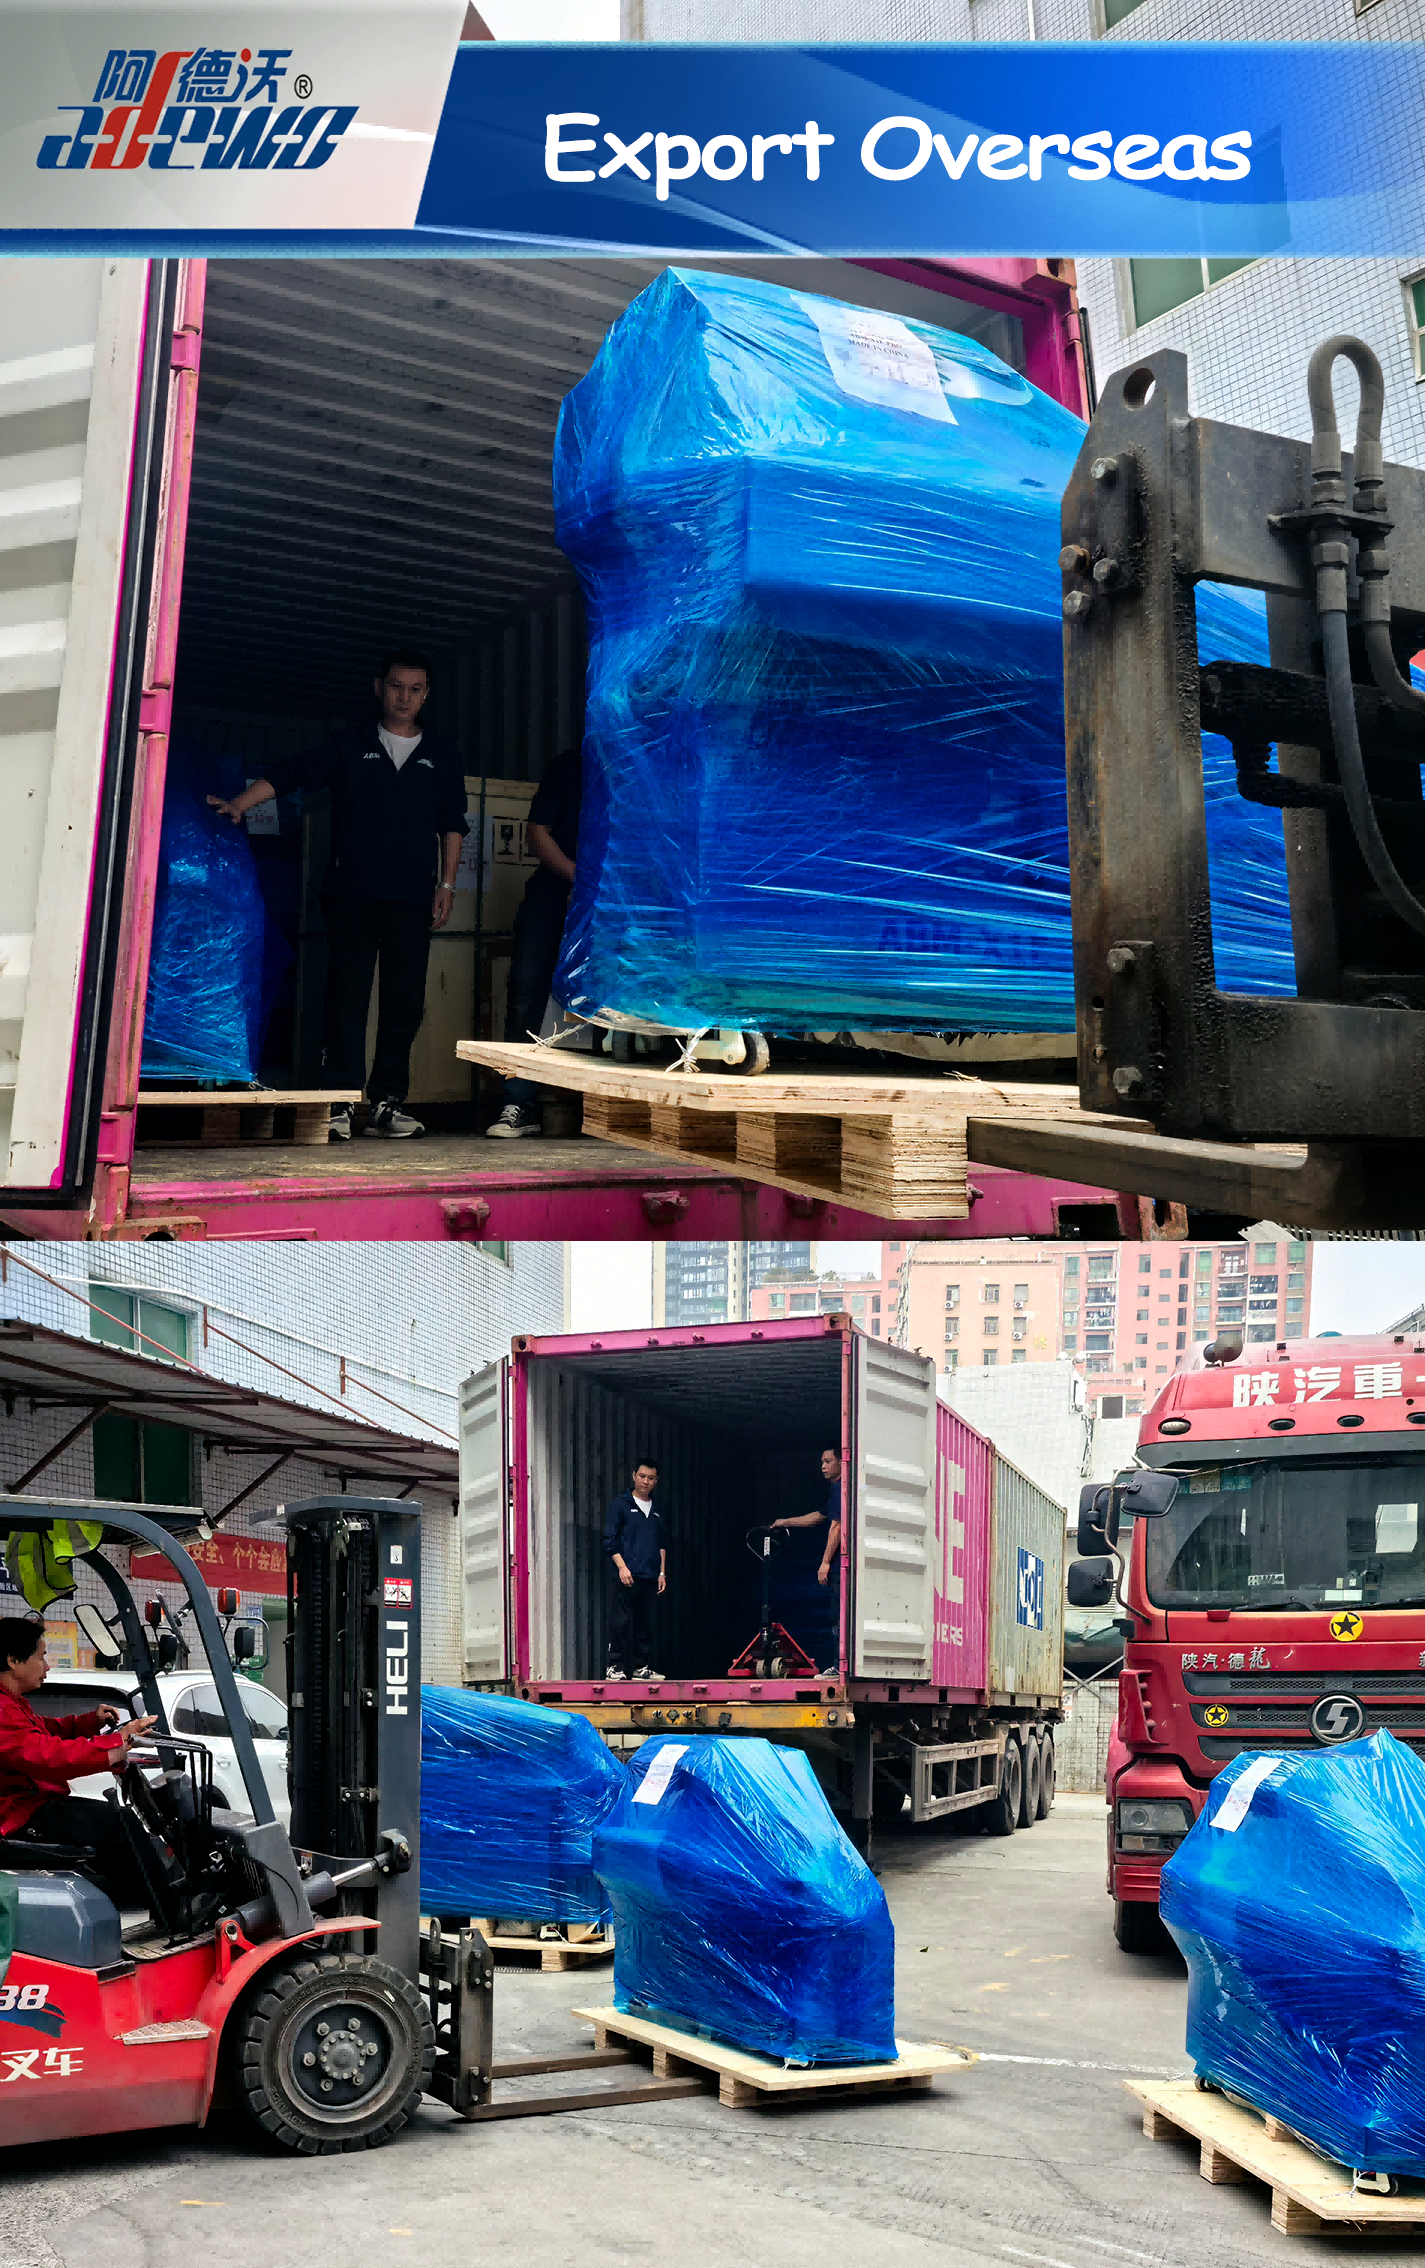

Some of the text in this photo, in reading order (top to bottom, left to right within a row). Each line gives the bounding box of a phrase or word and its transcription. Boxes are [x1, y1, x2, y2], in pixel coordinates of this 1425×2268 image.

[1233, 1362, 1425, 1408] 陕汽重
[934, 1621, 963, 1647] IERS
[386, 1621, 409, 1715] HELI
[0, 2047, 84, 2082] 叉车
